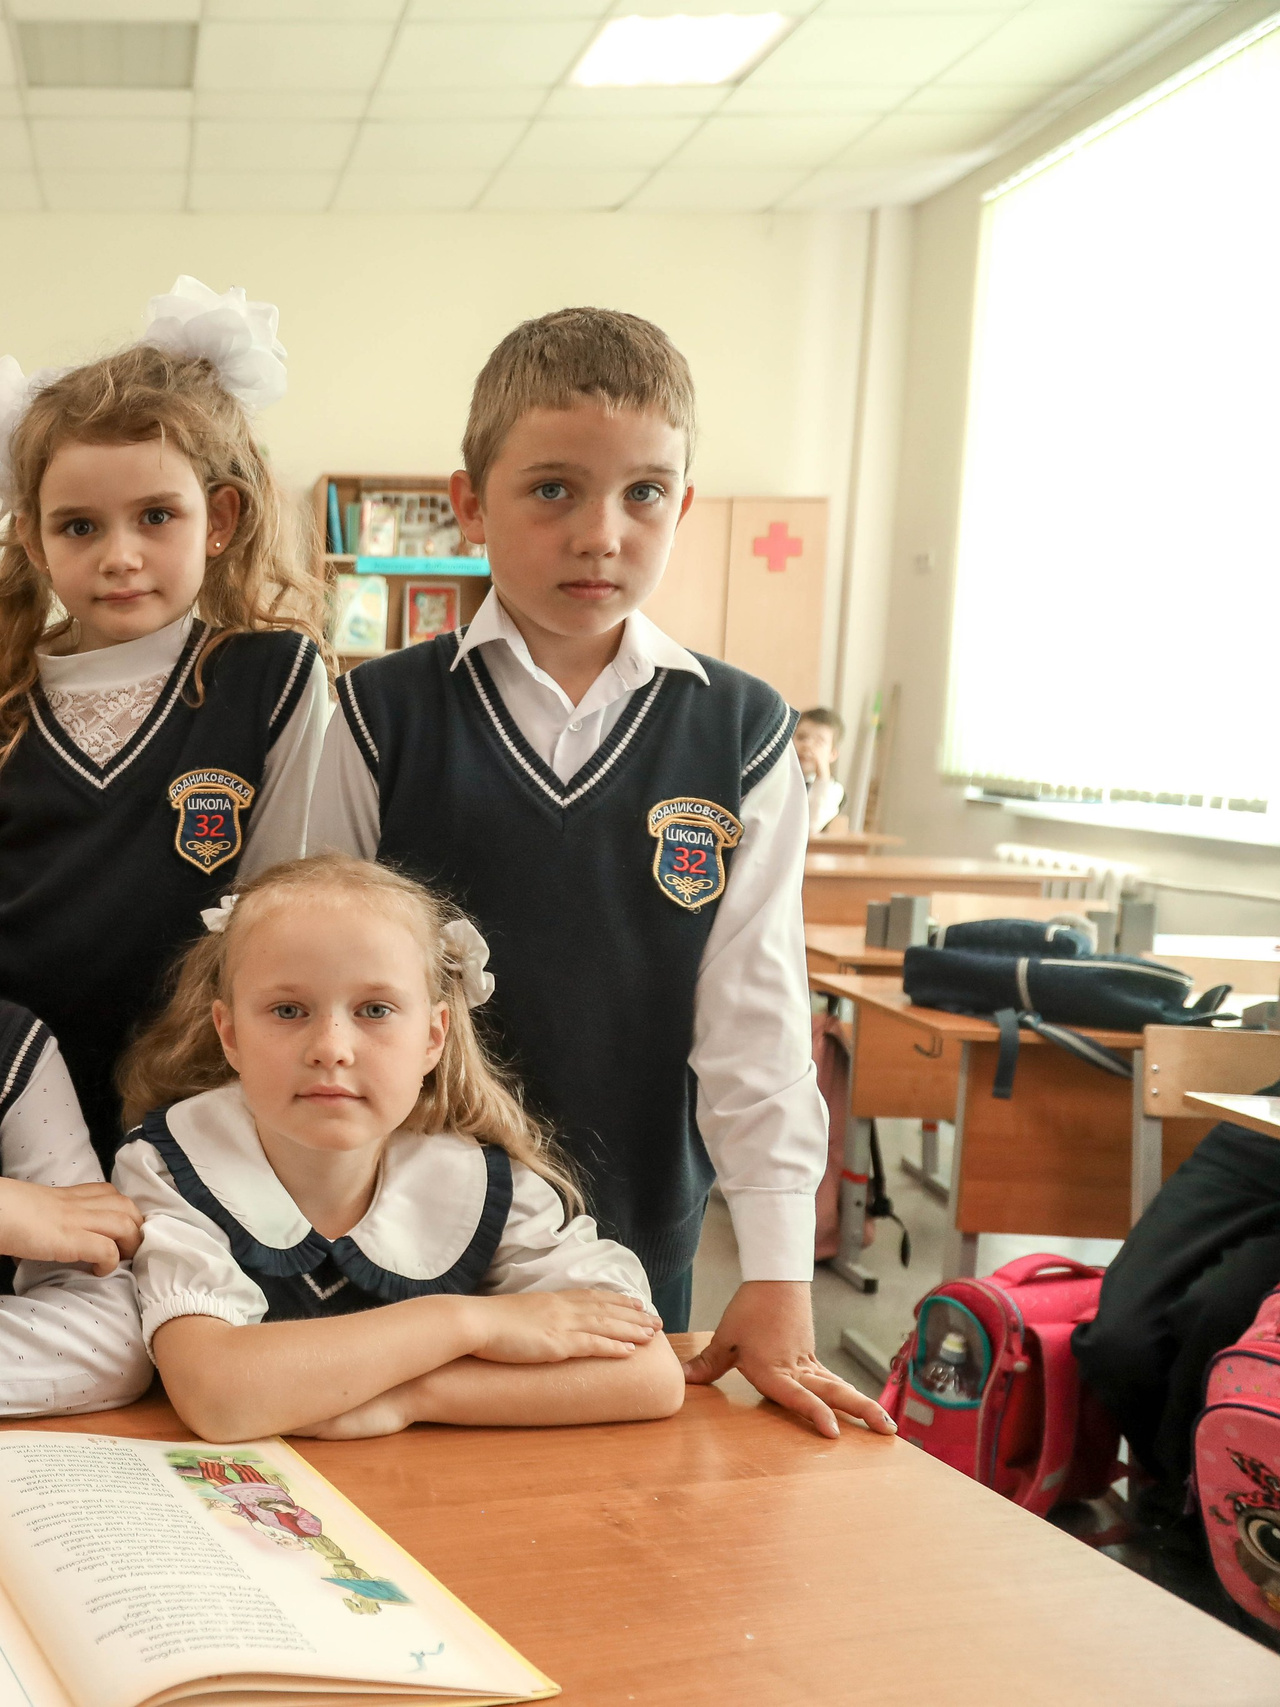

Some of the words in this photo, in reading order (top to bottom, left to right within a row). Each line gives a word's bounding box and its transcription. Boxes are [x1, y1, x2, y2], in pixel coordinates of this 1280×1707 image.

[171, 772, 250, 798] РОДНИКОВСКАЯ
[188, 798, 232, 811] ШКОЛА
[194, 814, 226, 838] 32
[651, 802, 737, 836] РОДНИКОВСКАЯ
[666, 828, 714, 847] ШКОЛА
[672, 847, 707, 874] 32
